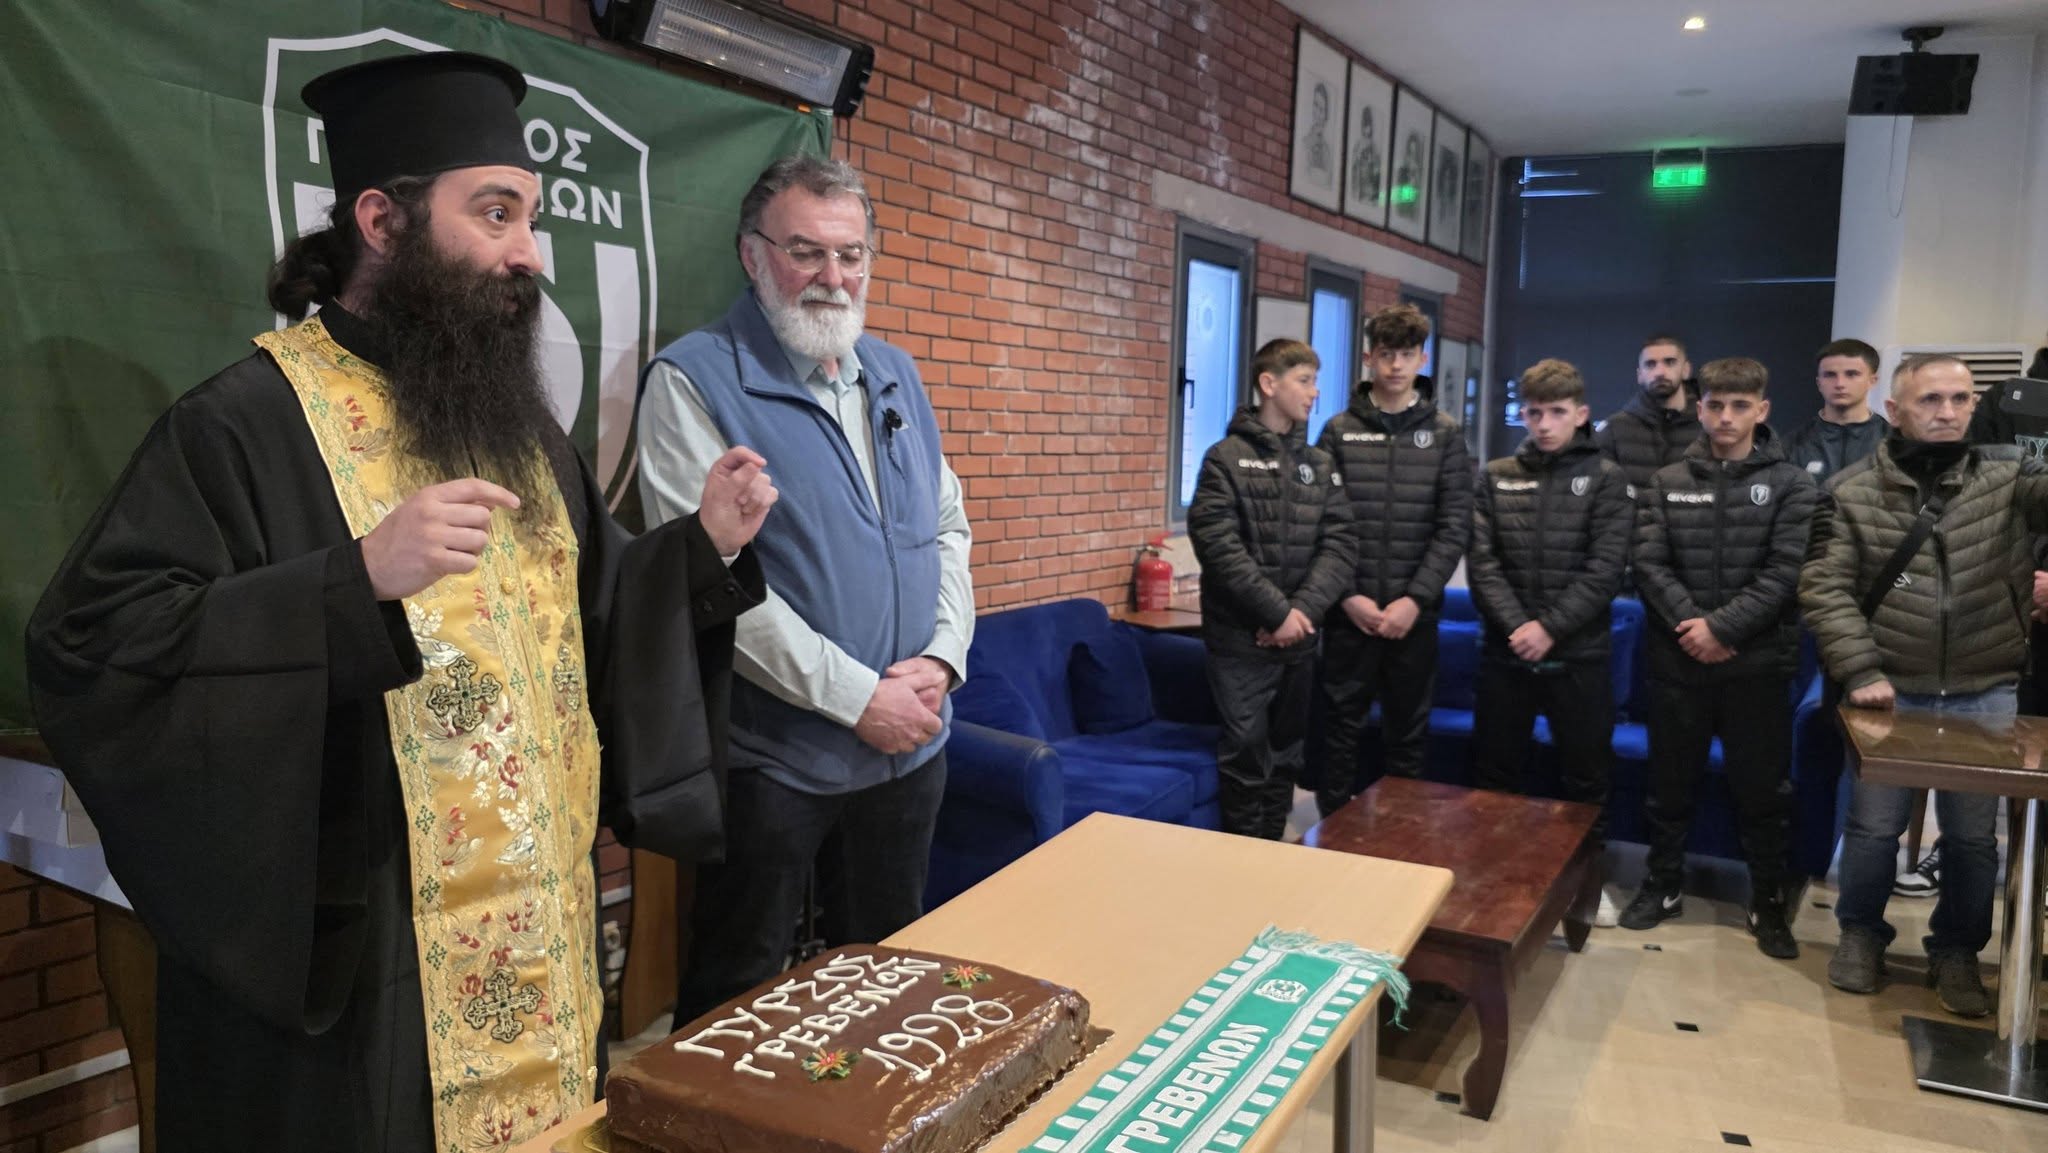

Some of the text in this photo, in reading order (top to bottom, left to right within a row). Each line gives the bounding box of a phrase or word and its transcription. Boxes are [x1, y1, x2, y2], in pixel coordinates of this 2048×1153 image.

[674, 953, 898, 1058] ΠΥΡΣΟΣ
[734, 957, 940, 1078] ΓΡΕΒΕΝΩΝ
[862, 994, 1013, 1081] 1928
